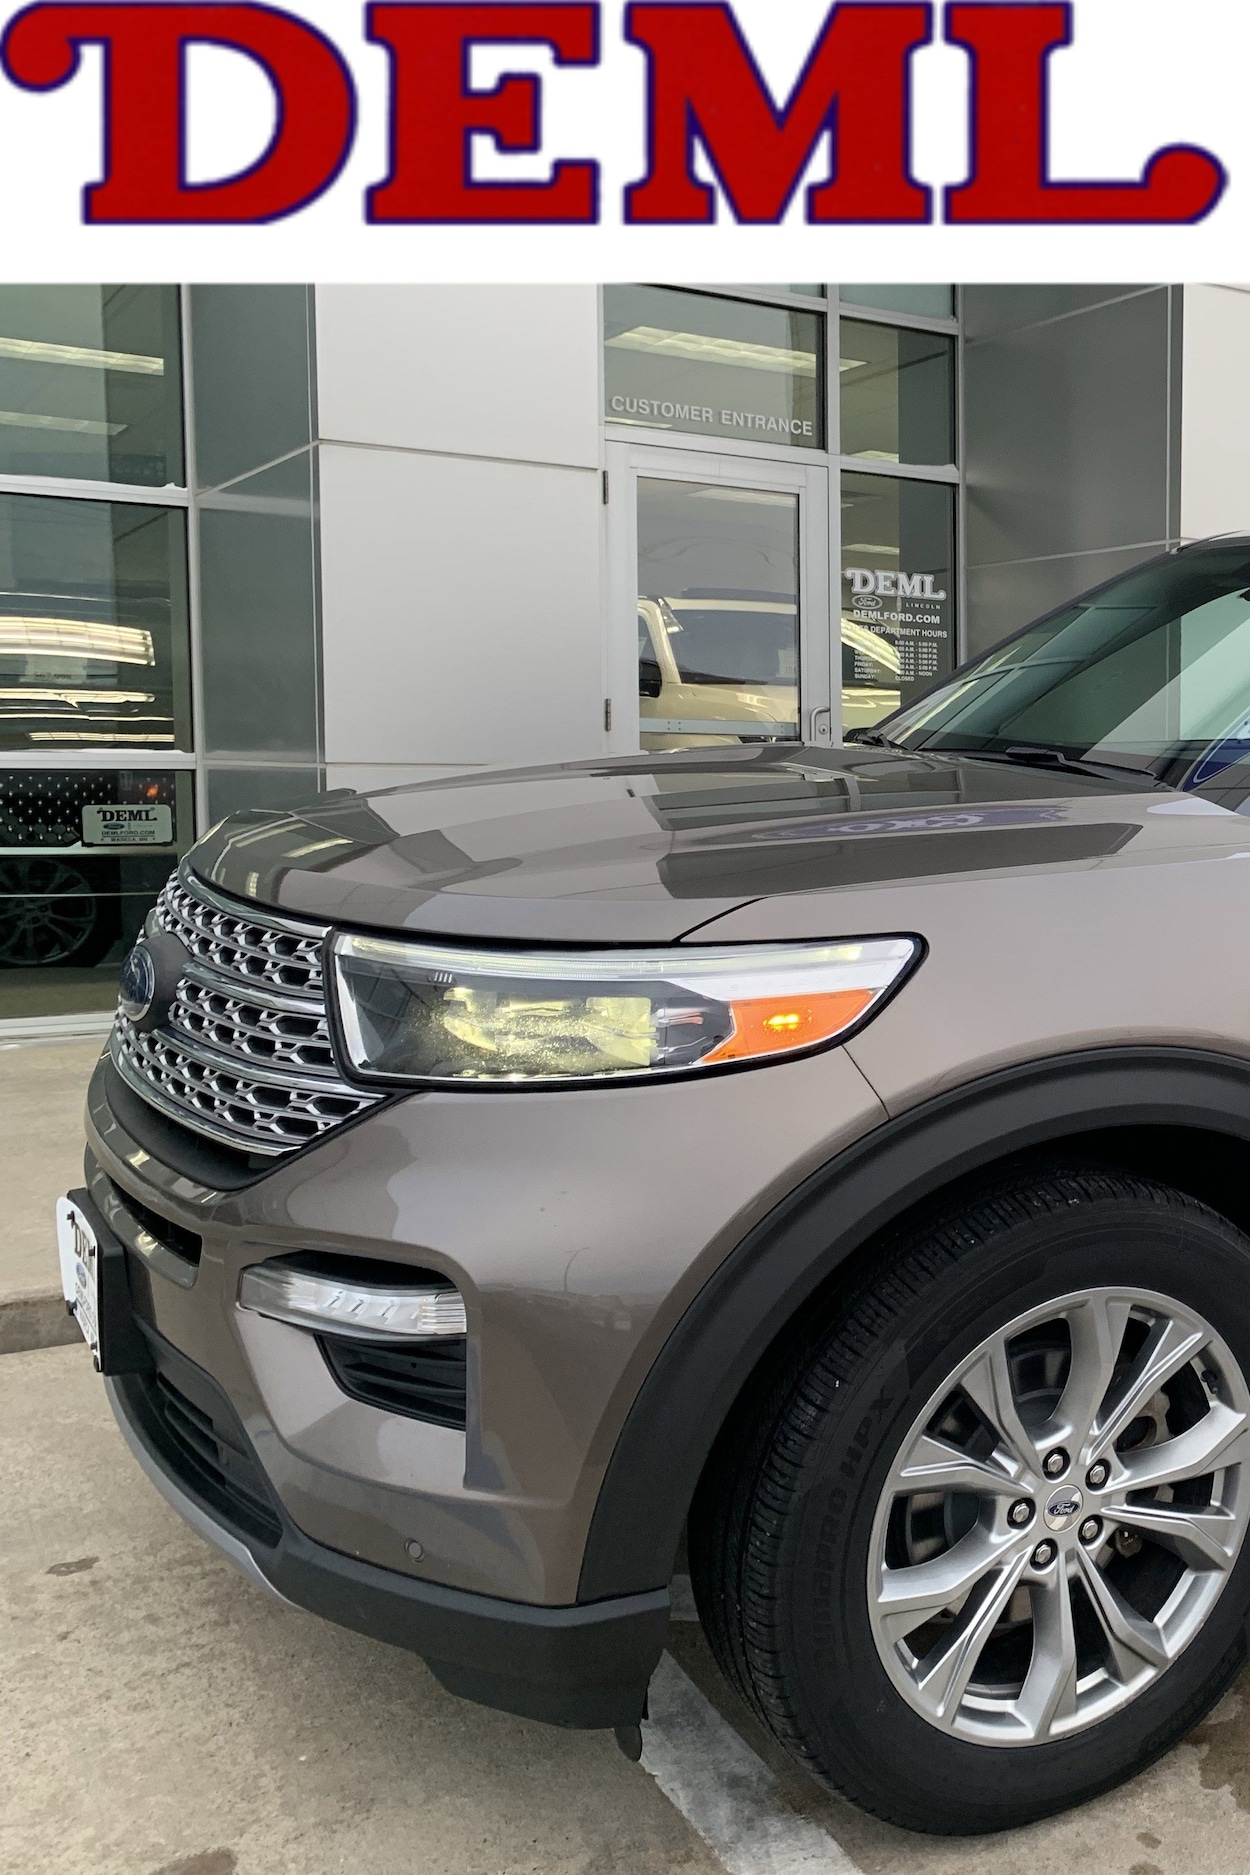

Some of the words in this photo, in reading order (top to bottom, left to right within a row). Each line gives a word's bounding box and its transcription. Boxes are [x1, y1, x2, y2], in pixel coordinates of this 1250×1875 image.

[611, 395, 714, 423] CUSTOMER
[721, 410, 813, 436] ENTRANCE
[845, 567, 947, 601] DEML
[905, 602, 941, 610] LINCOLN
[853, 609, 941, 624] DEMLFORD.COM
[870, 625, 921, 637] DEPARTMENT
[921, 629, 948, 638] HOURS
[97, 809, 157, 821] DEML
[1053, 1502, 1076, 1515] Ford
